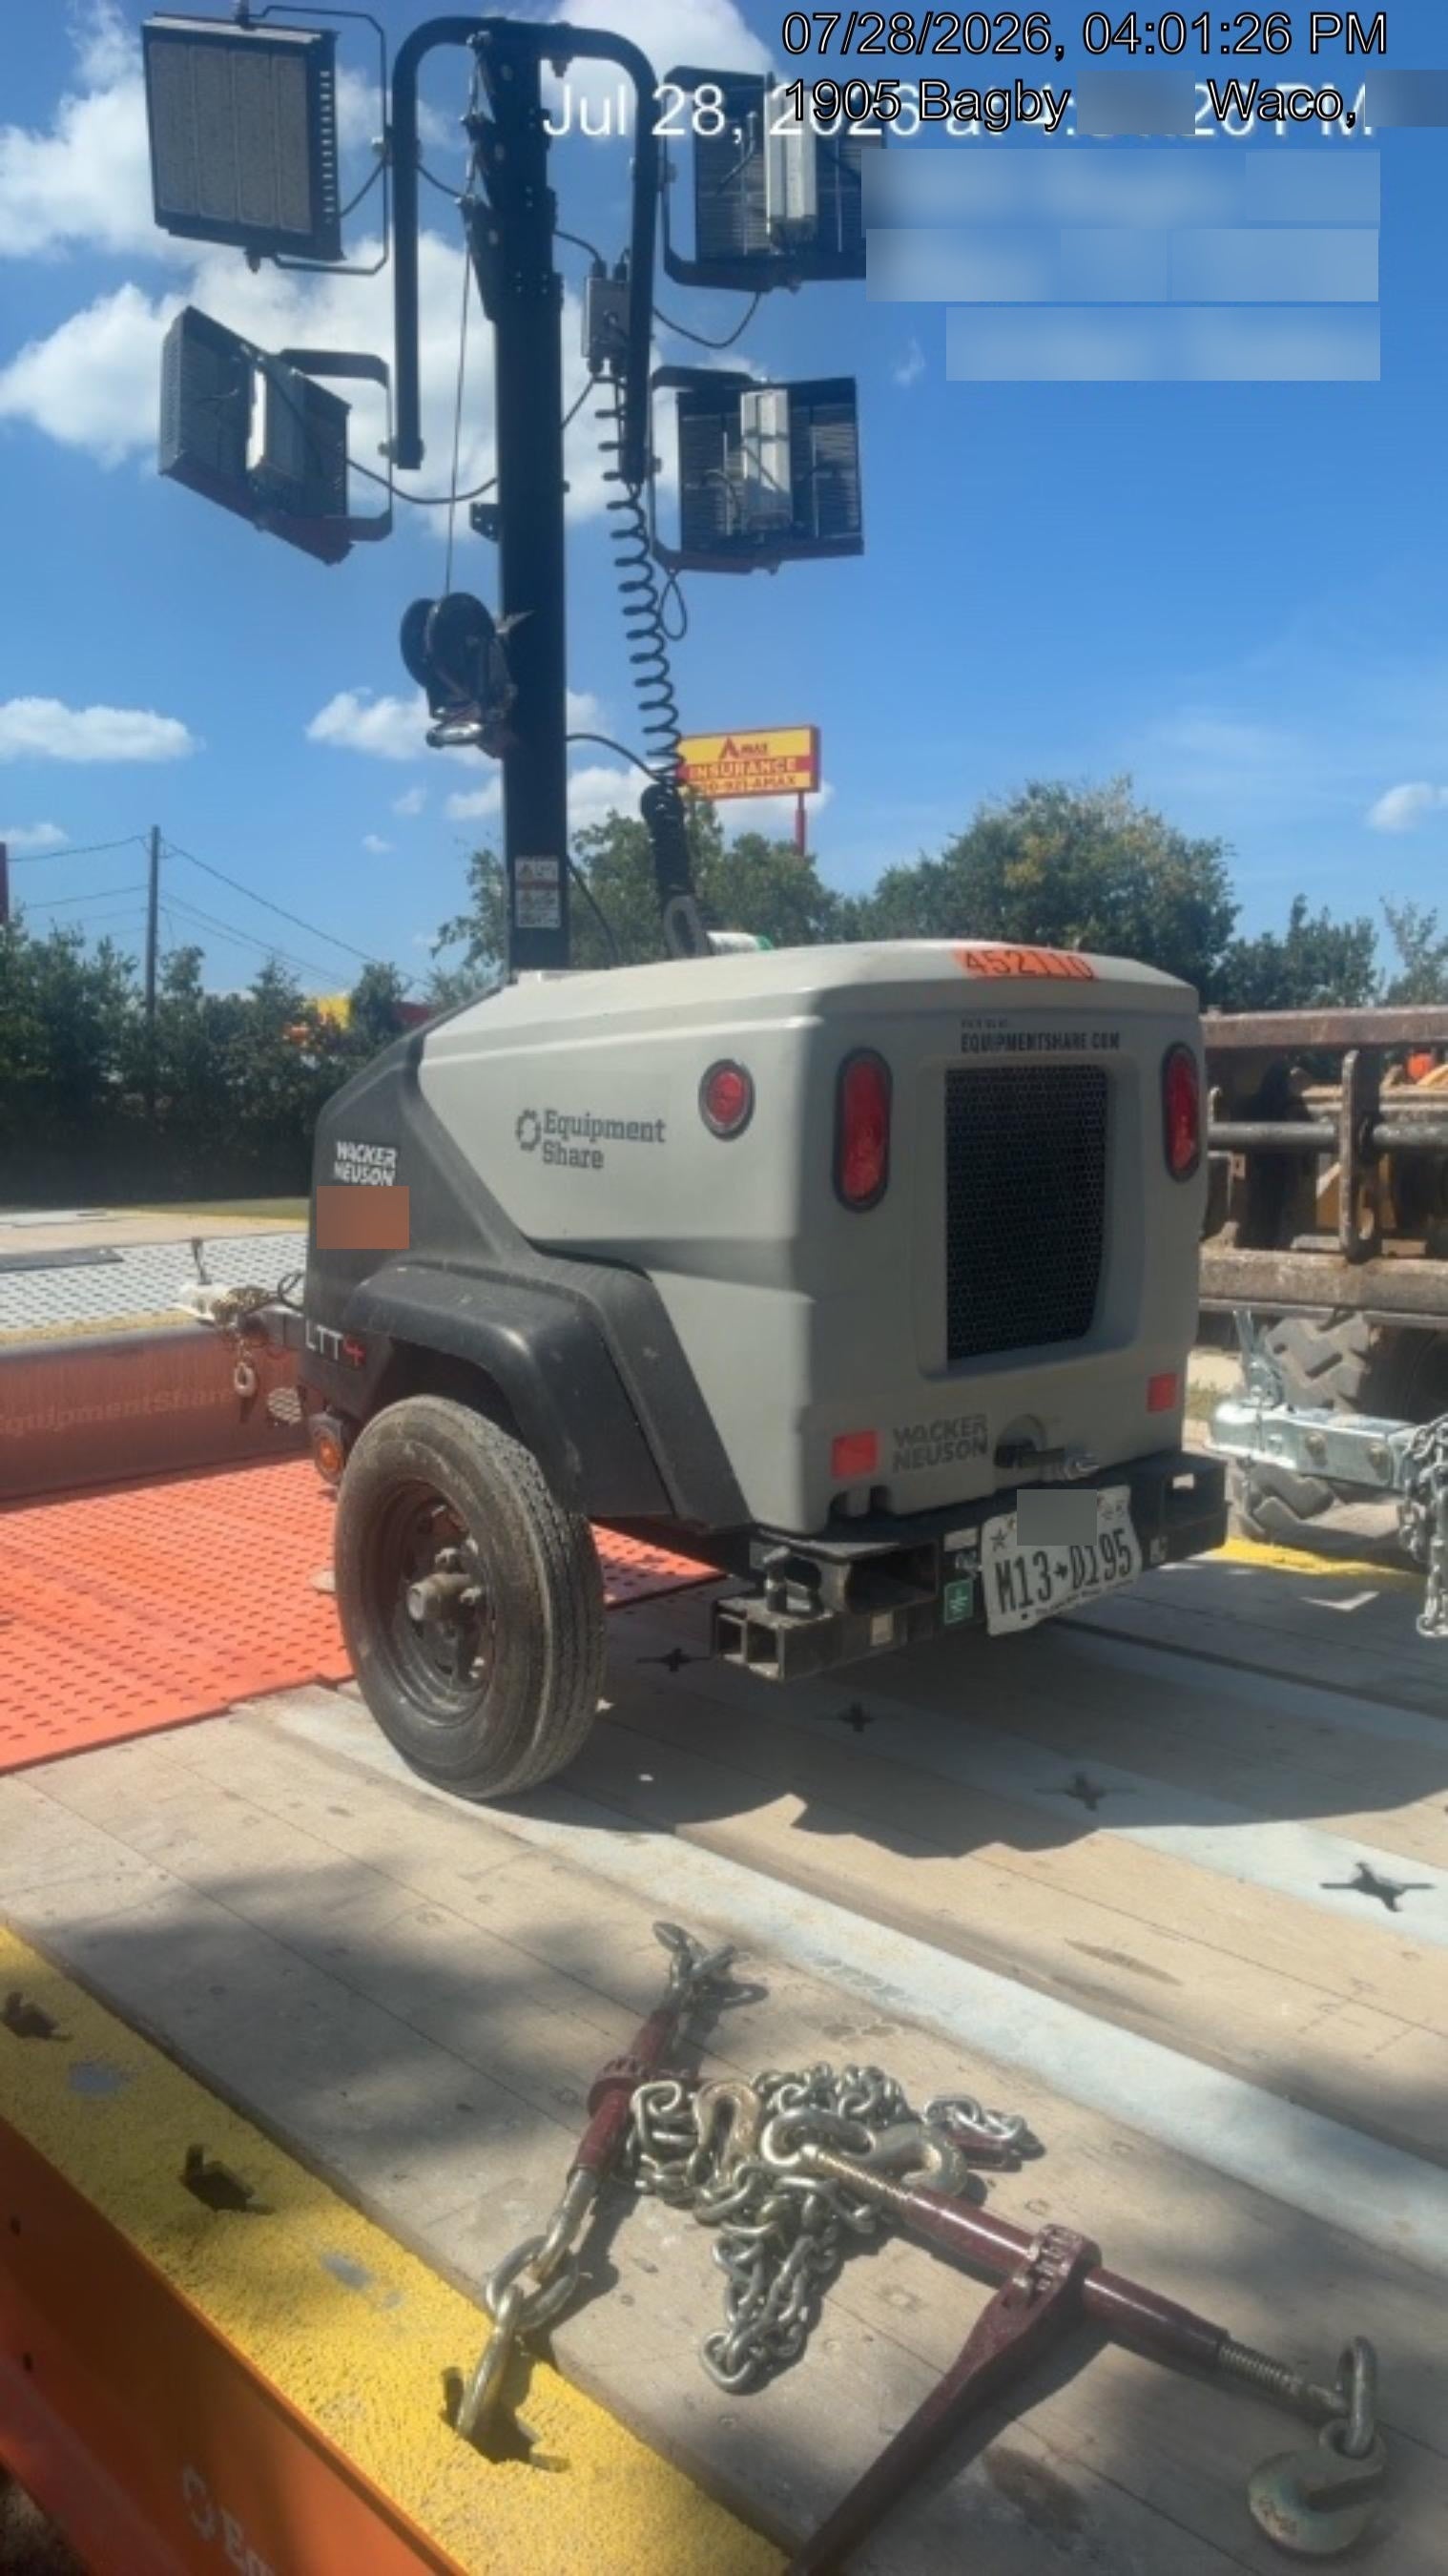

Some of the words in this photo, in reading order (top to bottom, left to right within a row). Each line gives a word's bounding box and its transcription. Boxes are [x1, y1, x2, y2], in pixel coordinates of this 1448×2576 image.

[543, 1109, 667, 1144] Equipment
[337, 1141, 398, 1169] WACKER
[542, 1140, 606, 1170] Share
[333, 1160, 397, 1187] NEUSON
[893, 1413, 988, 1449] WACKER
[892, 1433, 988, 1474] NEUSON
